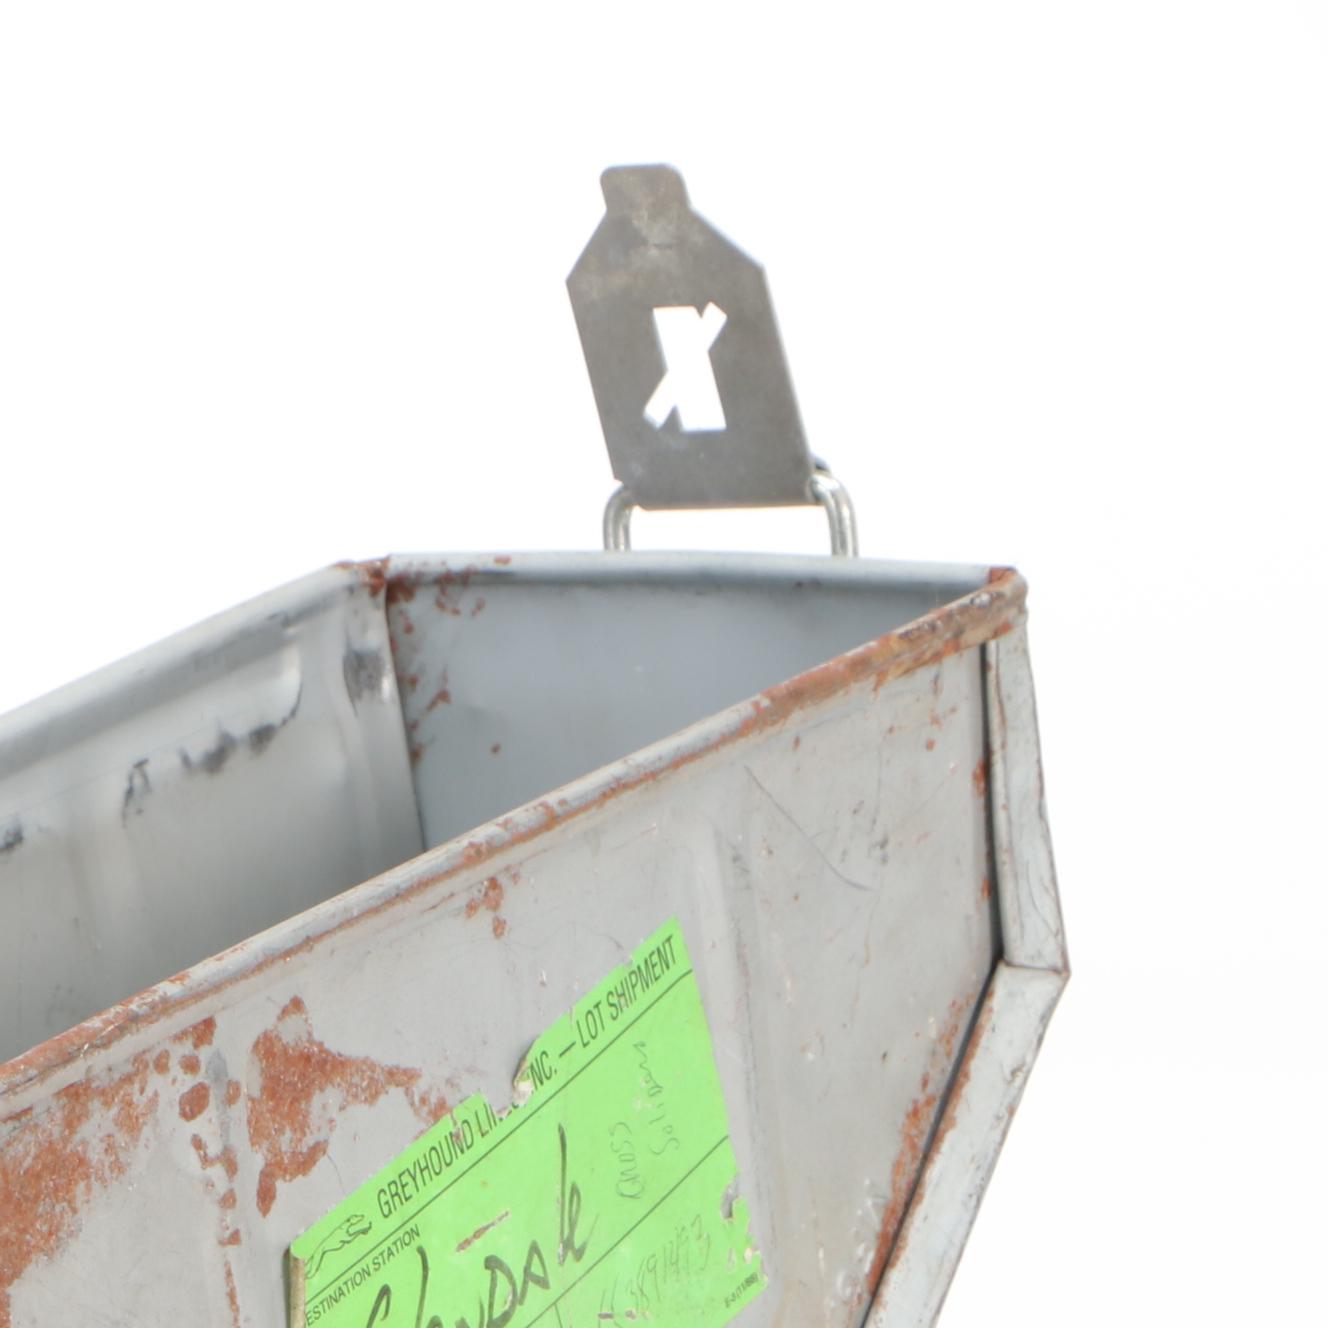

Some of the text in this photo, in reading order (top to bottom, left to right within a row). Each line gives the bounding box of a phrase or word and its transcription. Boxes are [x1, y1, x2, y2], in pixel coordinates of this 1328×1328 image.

[377, 1118, 475, 1218] GREYHOUND
[527, 1050, 558, 1091] NC.
[575, 997, 608, 1049] LOT
[607, 934, 678, 1024] SHIPMENT
[370, 1223, 421, 1272] STATION
